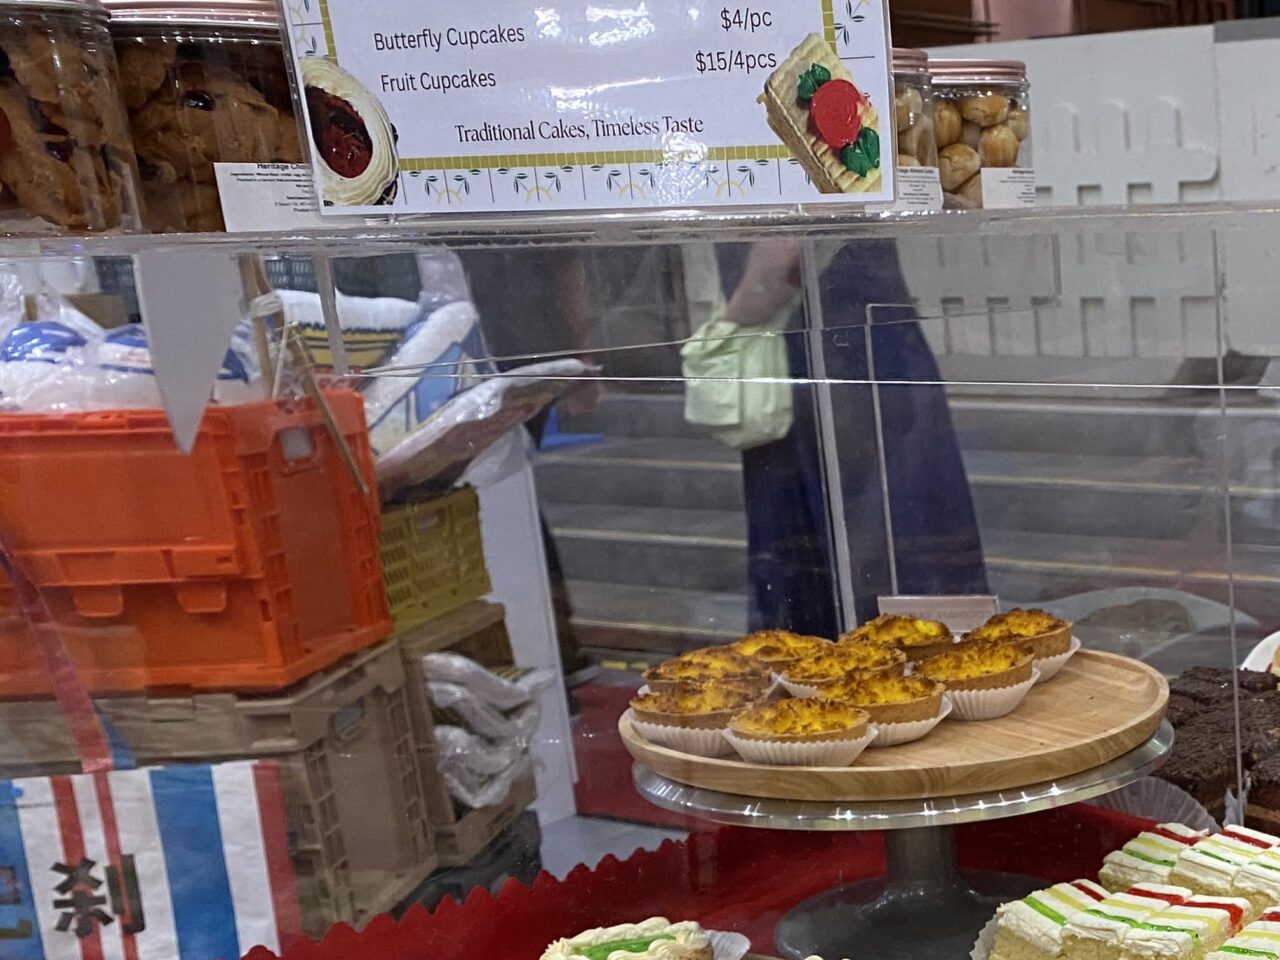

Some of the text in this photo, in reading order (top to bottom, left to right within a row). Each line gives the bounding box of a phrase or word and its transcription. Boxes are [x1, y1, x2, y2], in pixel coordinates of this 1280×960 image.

[720, 7, 773, 33] $4/pc
[373, 25, 525, 52] Butterfly Cupcakes
[695, 50, 777, 74] $15/4pcs
[381, 69, 497, 94] Fruit Cupcakes
[454, 116, 704, 143] Traditional Cakes, Timeless Taste
